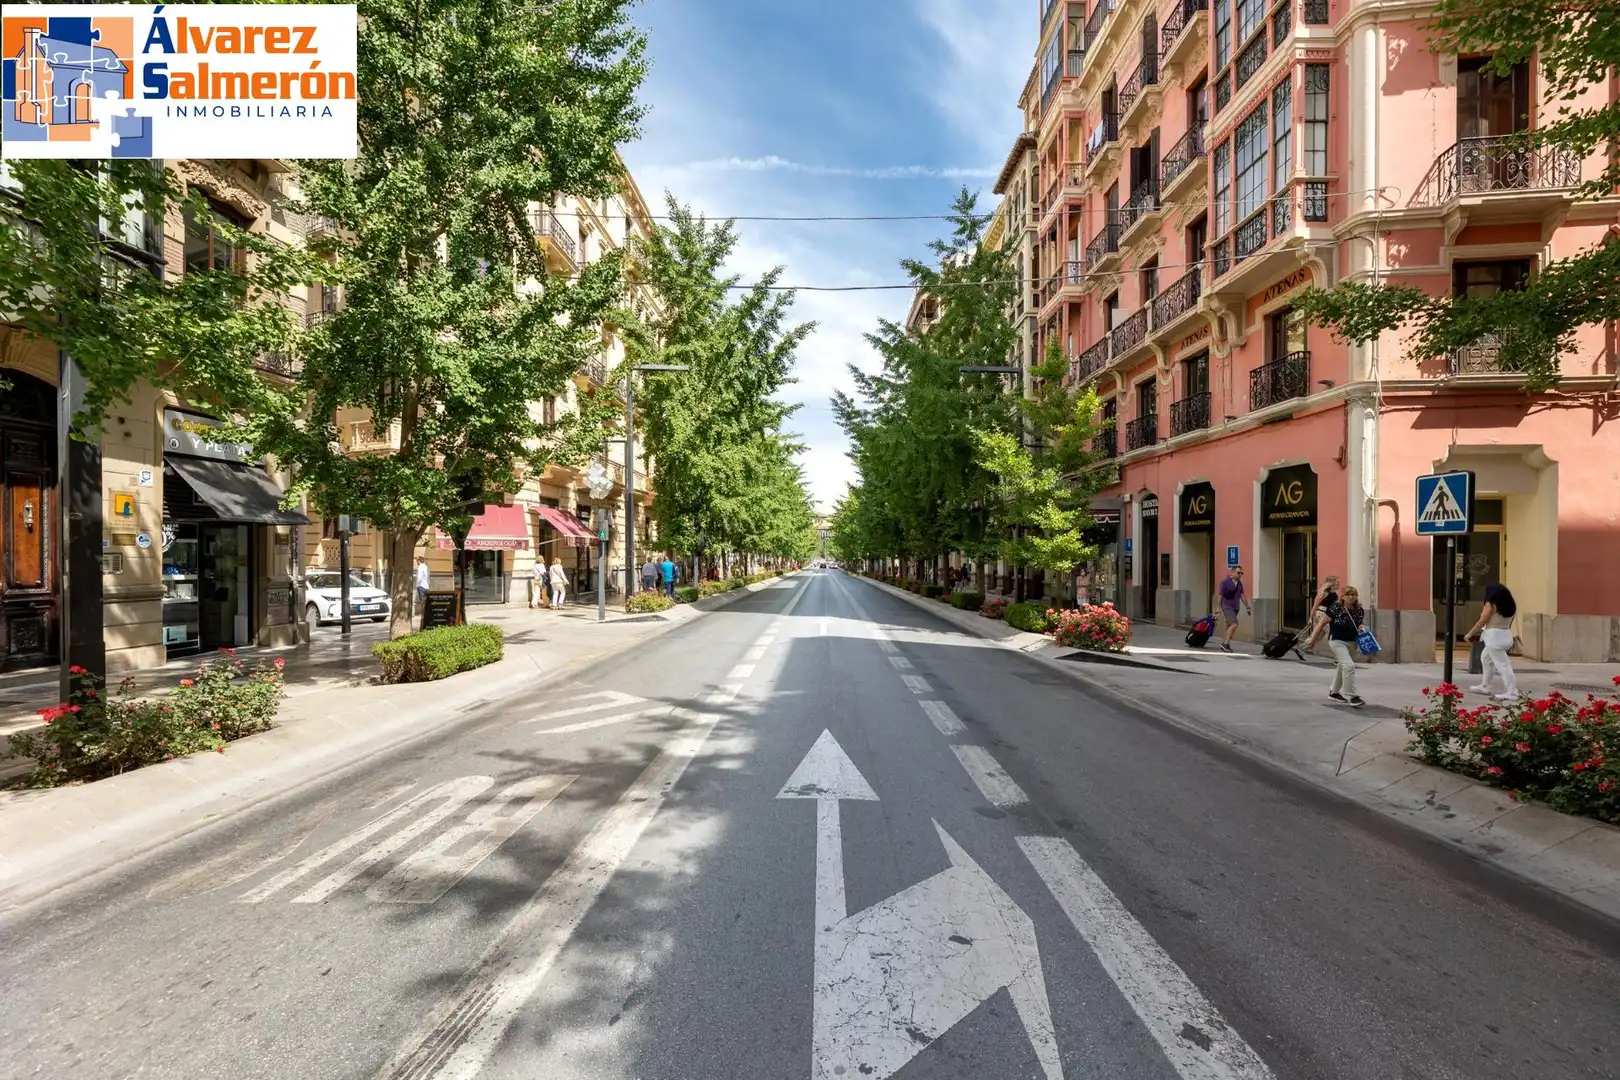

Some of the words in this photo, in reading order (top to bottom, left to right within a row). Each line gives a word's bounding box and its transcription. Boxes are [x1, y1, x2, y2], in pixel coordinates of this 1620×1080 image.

[1263, 268, 1306, 303] ATENAS
[1180, 325, 1209, 351] ATENAS
[192, 438, 200, 449] Y
[205, 441, 246, 457] PLATA
[1187, 495, 1207, 516] AG
[1274, 480, 1304, 507] AG
